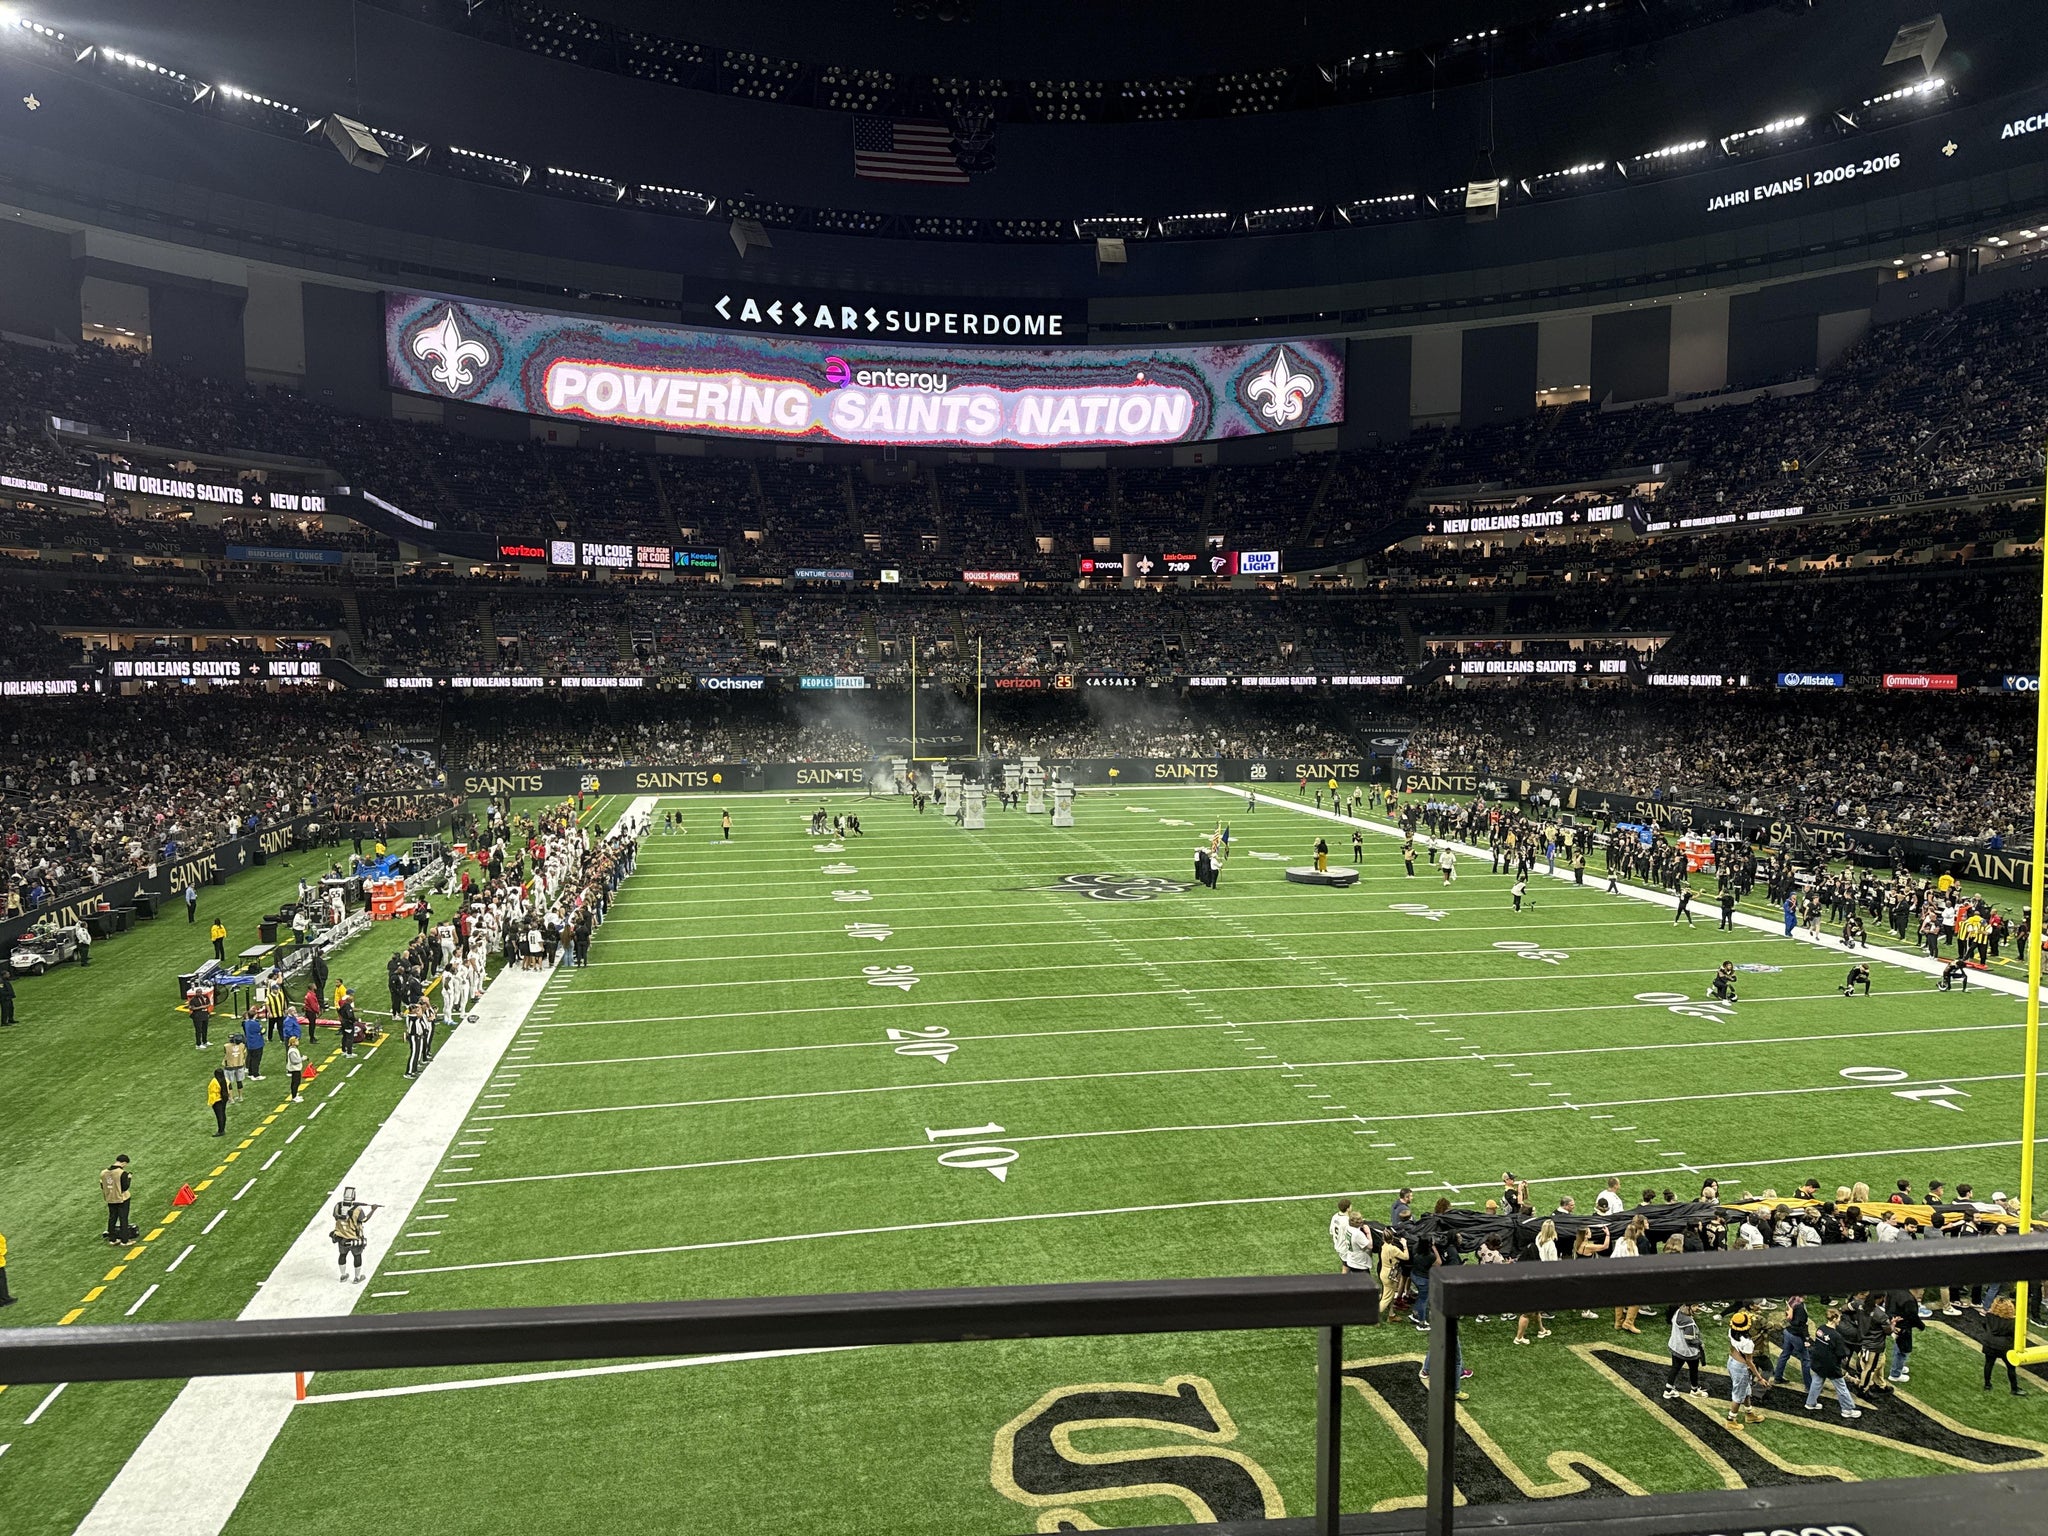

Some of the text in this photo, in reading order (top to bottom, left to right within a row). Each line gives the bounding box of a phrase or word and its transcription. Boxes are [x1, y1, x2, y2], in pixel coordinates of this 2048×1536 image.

[1706, 152, 1902, 212] JAHRI EVANS 2006-2016
[714, 295, 1063, 336] CAESARS SUPERDOME
[856, 369, 948, 394] entergy
[550, 366, 1187, 435] POWERING SAINTS NATION
[26, 481, 48, 493] SAINTS
[58, 485, 70, 495] NEW
[113, 471, 138, 492] NEW
[139, 476, 196, 499] ORLEANS
[197, 484, 244, 505] SAINTS
[269, 492, 299, 511] NEW
[1443, 518, 1469, 534] NEW
[1470, 514, 1520, 532] ORLEANS
[1521, 510, 1564, 528] SAINTS
[1587, 506, 1612, 522] NEW
[63, 535, 100, 547] SAINTS
[265, 551, 292, 559] LIGHT
[294, 551, 324, 561] LOUNGE
[500, 544, 546, 558] verizon
[582, 543, 633, 558] FAN CODE
[636, 552, 671, 563] QR CODE
[582, 556, 633, 568] OF CONDUCT
[690, 560, 718, 568] Federal
[1247, 554, 1267, 562] BUD
[1168, 562, 1190, 572] 7:09
[1243, 562, 1277, 571] LIGHT
[796, 570, 826, 578] VENTURE
[963, 572, 1019, 581] ROUSES MARKETS
[134, 661, 191, 677] ORLEANS
[192, 661, 240, 676] SAINTS
[268, 661, 299, 676] NEW
[1460, 661, 1486, 673] NEW
[1486, 660, 1535, 673] ORLEANS
[1536, 660, 1577, 673] SAINTS
[1599, 660, 1619, 673] NEW
[399, 677, 433, 688] SAINTS
[451, 677, 471, 688] NEW
[472, 677, 511, 688] ORLEANS
[511, 677, 544, 688] SAINTS
[561, 677, 581, 688] NEW
[581, 677, 618, 687] ORLEANS
[659, 676, 692, 684] SAINTS
[707, 677, 764, 690] Ochsner
[801, 676, 864, 687] PEOPLES HEALTH
[875, 676, 906, 684] SAINTS
[941, 676, 971, 684] SAINTS
[994, 677, 1041, 688] verizon
[1057, 676, 1072, 687] 25
[1085, 677, 1137, 687] CAESARS
[1200, 677, 1227, 686] SAINTS
[1241, 677, 1257, 686] NEW
[1258, 677, 1290, 686] ORLEANS
[1290, 677, 1317, 686] SAINTS
[1331, 676, 1348, 685] NEW
[1349, 676, 1381, 685] ORLEANS
[1653, 674, 1690, 686] ORLEANS
[1690, 675, 1722, 687] SAINTS
[1848, 675, 1882, 685] SAINTS
[1886, 675, 1930, 688] Community
[3, 680, 44, 696] ORLEANS
[45, 680, 77, 695] SAINTS
[886, 735, 964, 744] SAINTS
[796, 767, 863, 785] SAINTS
[1154, 763, 1219, 779] SAINTS
[1295, 763, 1360, 779] SAINTS
[464, 774, 544, 795] SAINTS
[636, 770, 709, 789] SAINTS
[1406, 775, 1478, 793] SAINTS
[1635, 800, 1693, 828] SAINTS
[259, 823, 295, 853] SAINTS
[169, 852, 219, 893] SAINTS
[844, 922, 894, 938] 40
[862, 965, 921, 987] 30
[1633, 992, 1739, 1017] 20
[886, 1025, 960, 1056] 20
[1838, 1066, 1973, 1102] 10
[924, 1122, 1020, 1168] 10
